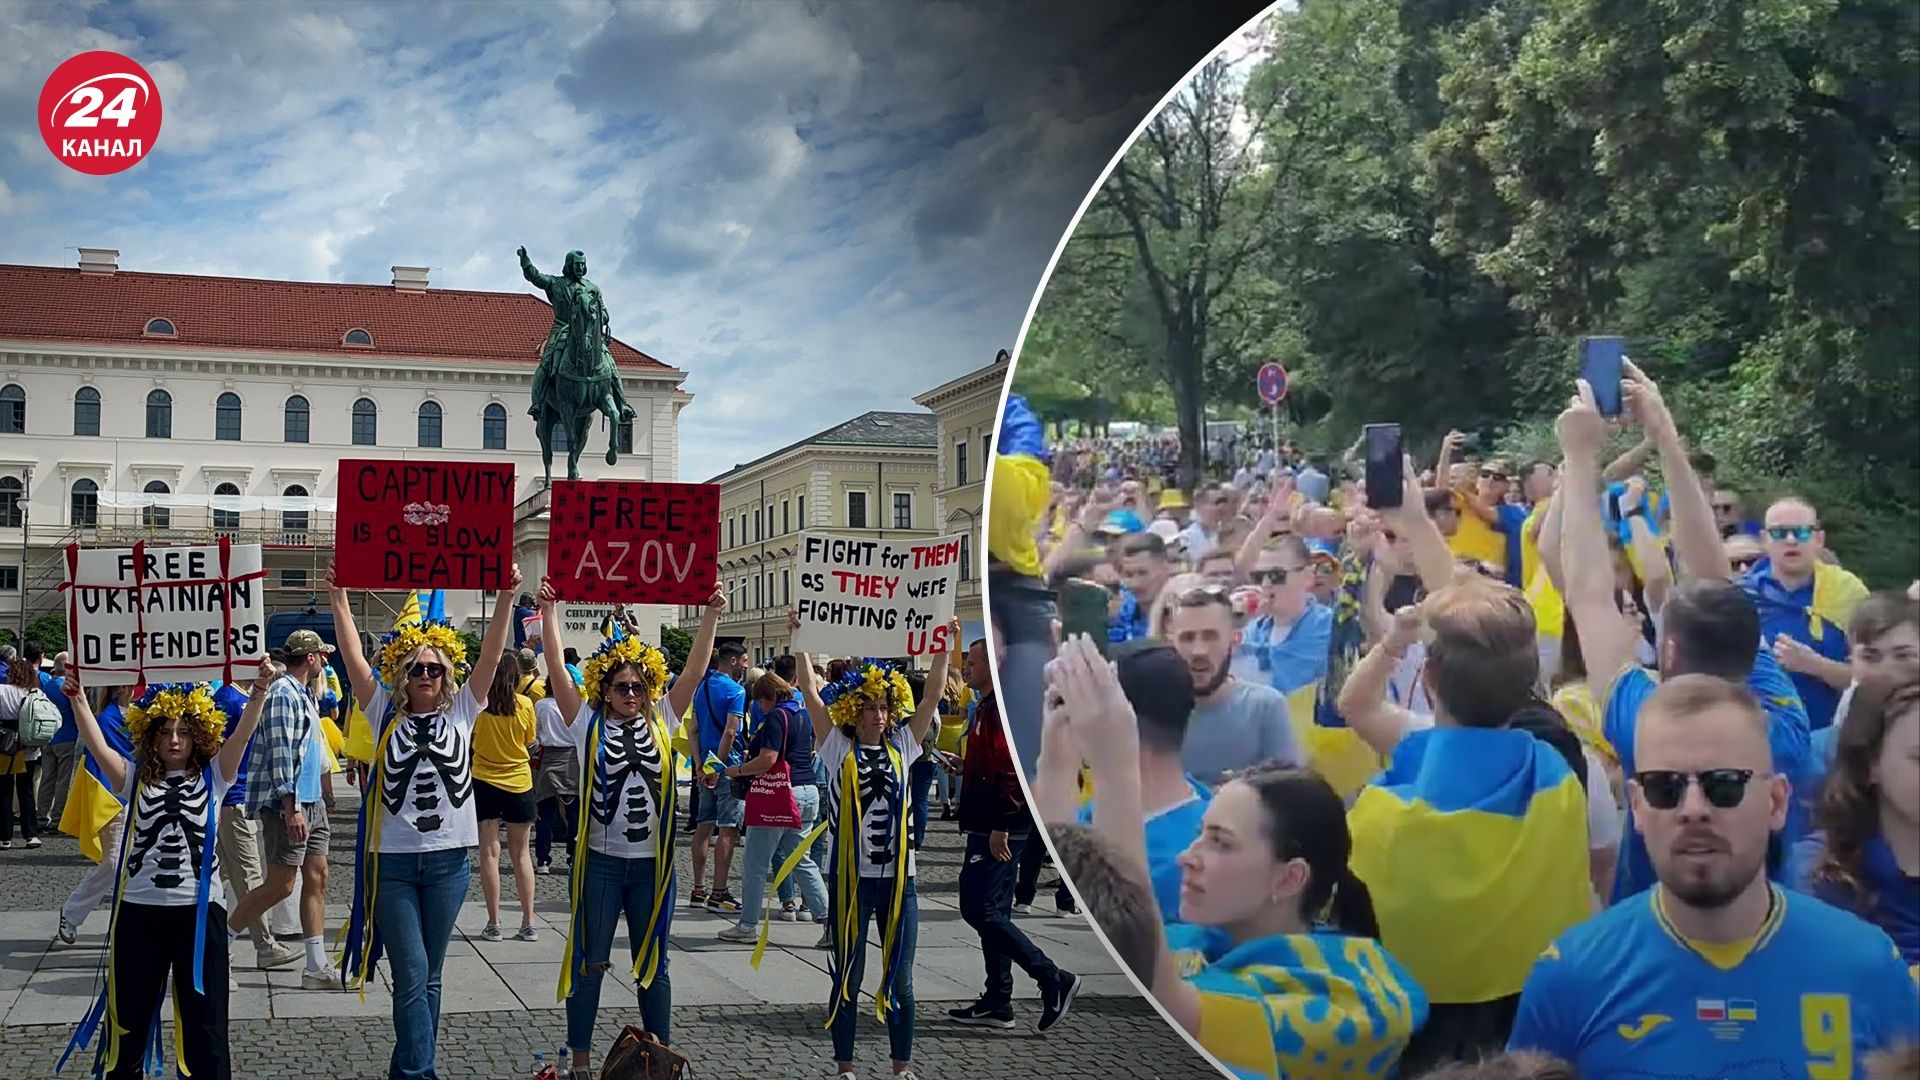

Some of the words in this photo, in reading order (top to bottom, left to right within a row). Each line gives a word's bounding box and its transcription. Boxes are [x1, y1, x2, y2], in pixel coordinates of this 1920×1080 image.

[358, 465, 514, 503] CAPTIVITY
[589, 496, 687, 532] FREE
[426, 525, 500, 549] SLOW
[805, 537, 878, 566] FIGHT
[881, 546, 909, 570] for
[911, 540, 960, 570] THEM
[118, 551, 205, 580] FREE
[384, 551, 501, 588] DEATH
[574, 540, 696, 584] AZOV
[82, 580, 250, 614] UKRAINIAN
[831, 570, 899, 600] THEY
[565, 622, 585, 630] VON
[798, 599, 898, 630] FIGHTING
[904, 607, 933, 630] for
[83, 623, 260, 664] DEFENDERS
[907, 625, 949, 656] US
[1801, 993, 1852, 1080] 9
